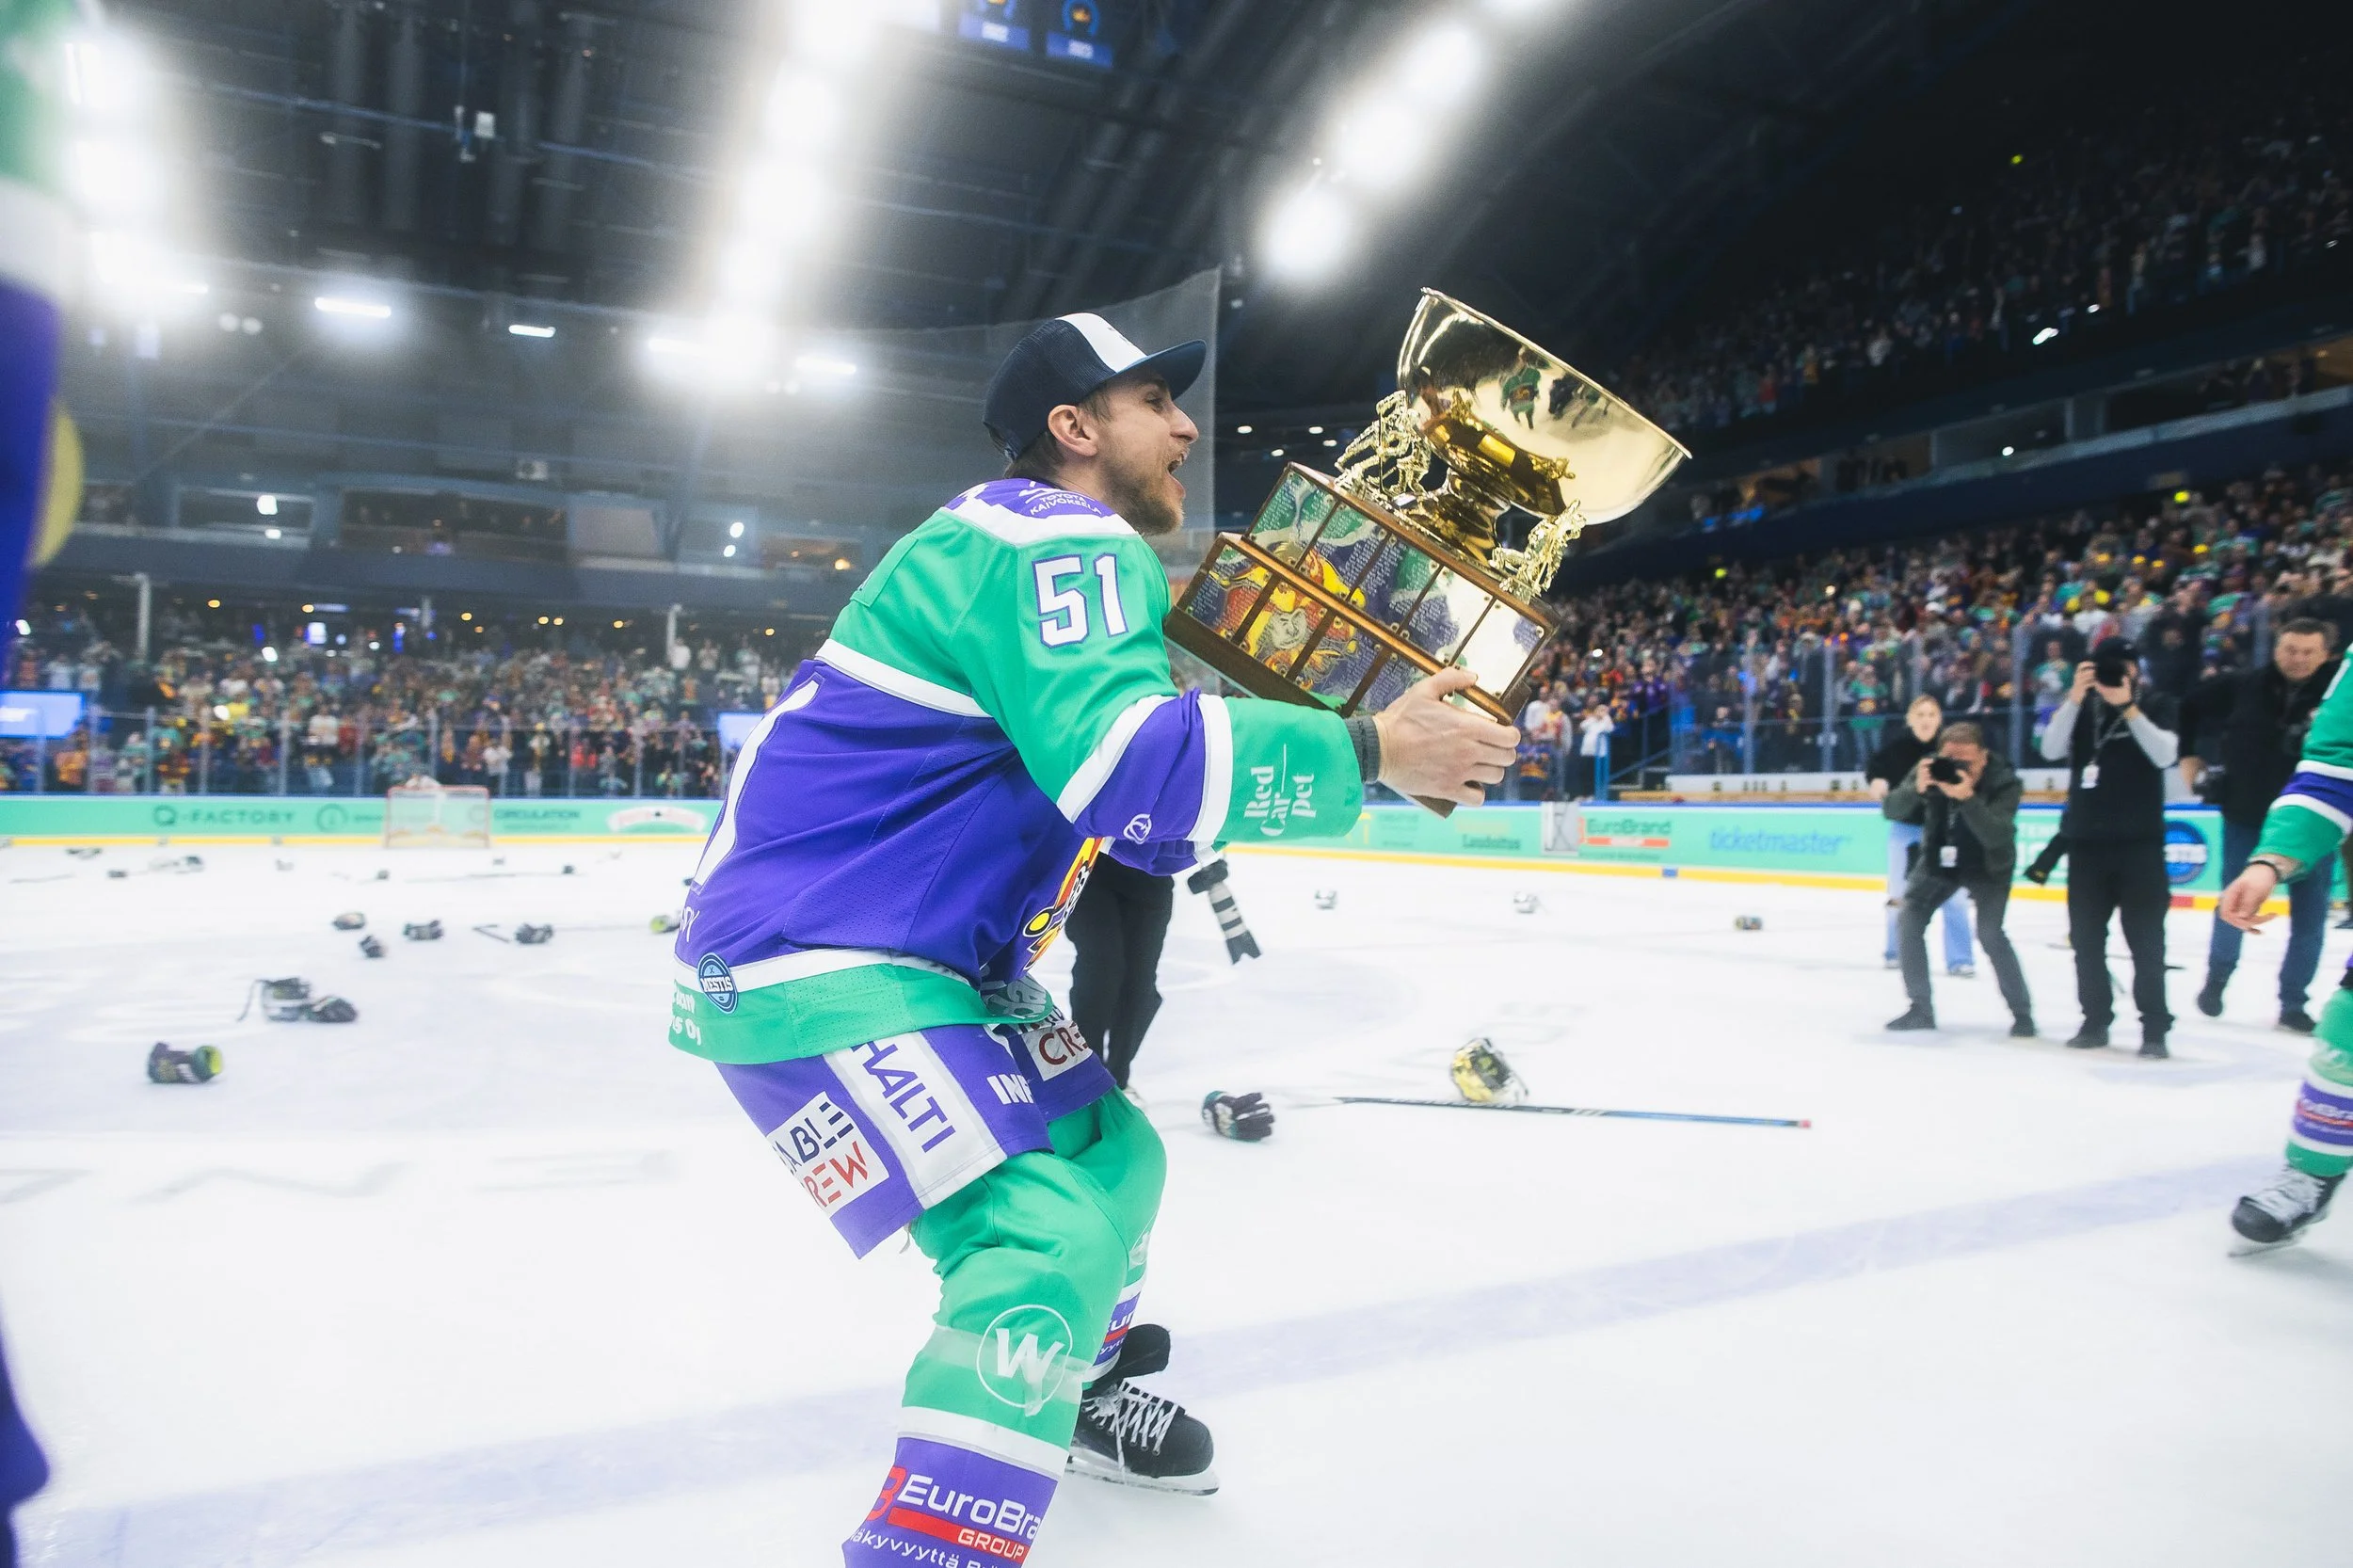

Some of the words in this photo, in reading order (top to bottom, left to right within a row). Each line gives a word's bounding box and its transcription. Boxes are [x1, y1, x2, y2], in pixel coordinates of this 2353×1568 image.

[1040, 493, 1087, 503] TOYOTA
[1032, 552, 1128, 648] 51
[1243, 765, 1274, 818] Red
[1291, 772, 1317, 819] pet
[700, 976, 734, 993] MESTIS
[801, 1141, 868, 1208] REW
[897, 1474, 1042, 1541] EuroBra
[958, 1528, 1025, 1560] GROUP
